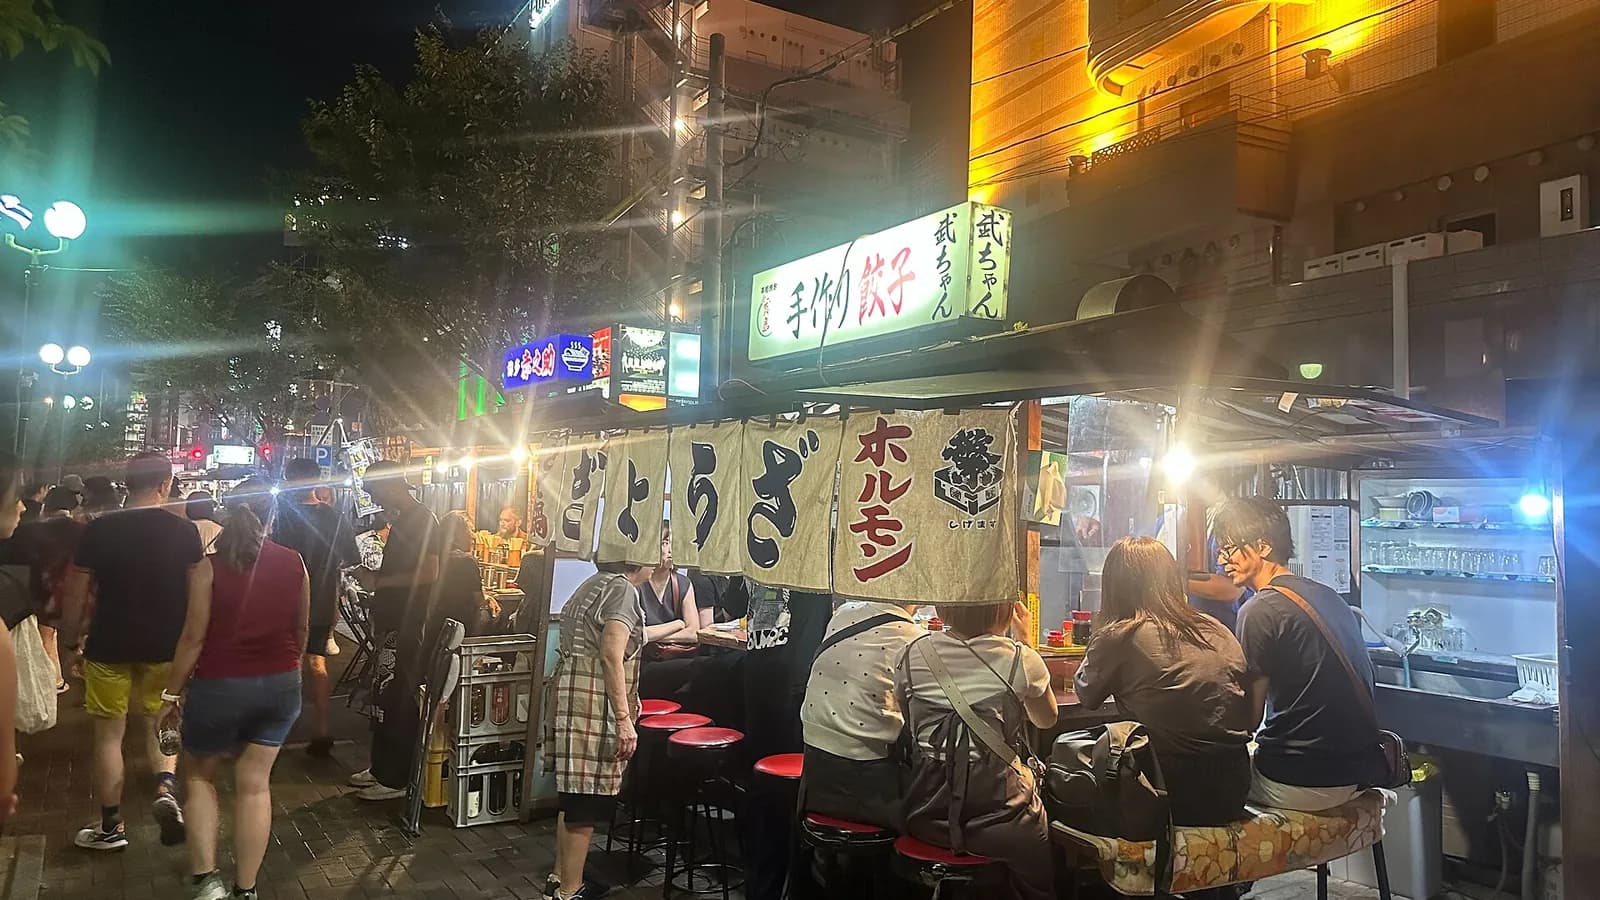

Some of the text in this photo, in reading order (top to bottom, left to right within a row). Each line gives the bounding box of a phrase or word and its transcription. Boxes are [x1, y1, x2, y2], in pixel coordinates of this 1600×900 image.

[932, 213, 957, 320] 武ちゃん
[971, 209, 1005, 320] 武ちゃん
[315, 447, 329, 464] P
[849, 416, 914, 583] ホルモン
[948, 519, 998, 530] しげます
